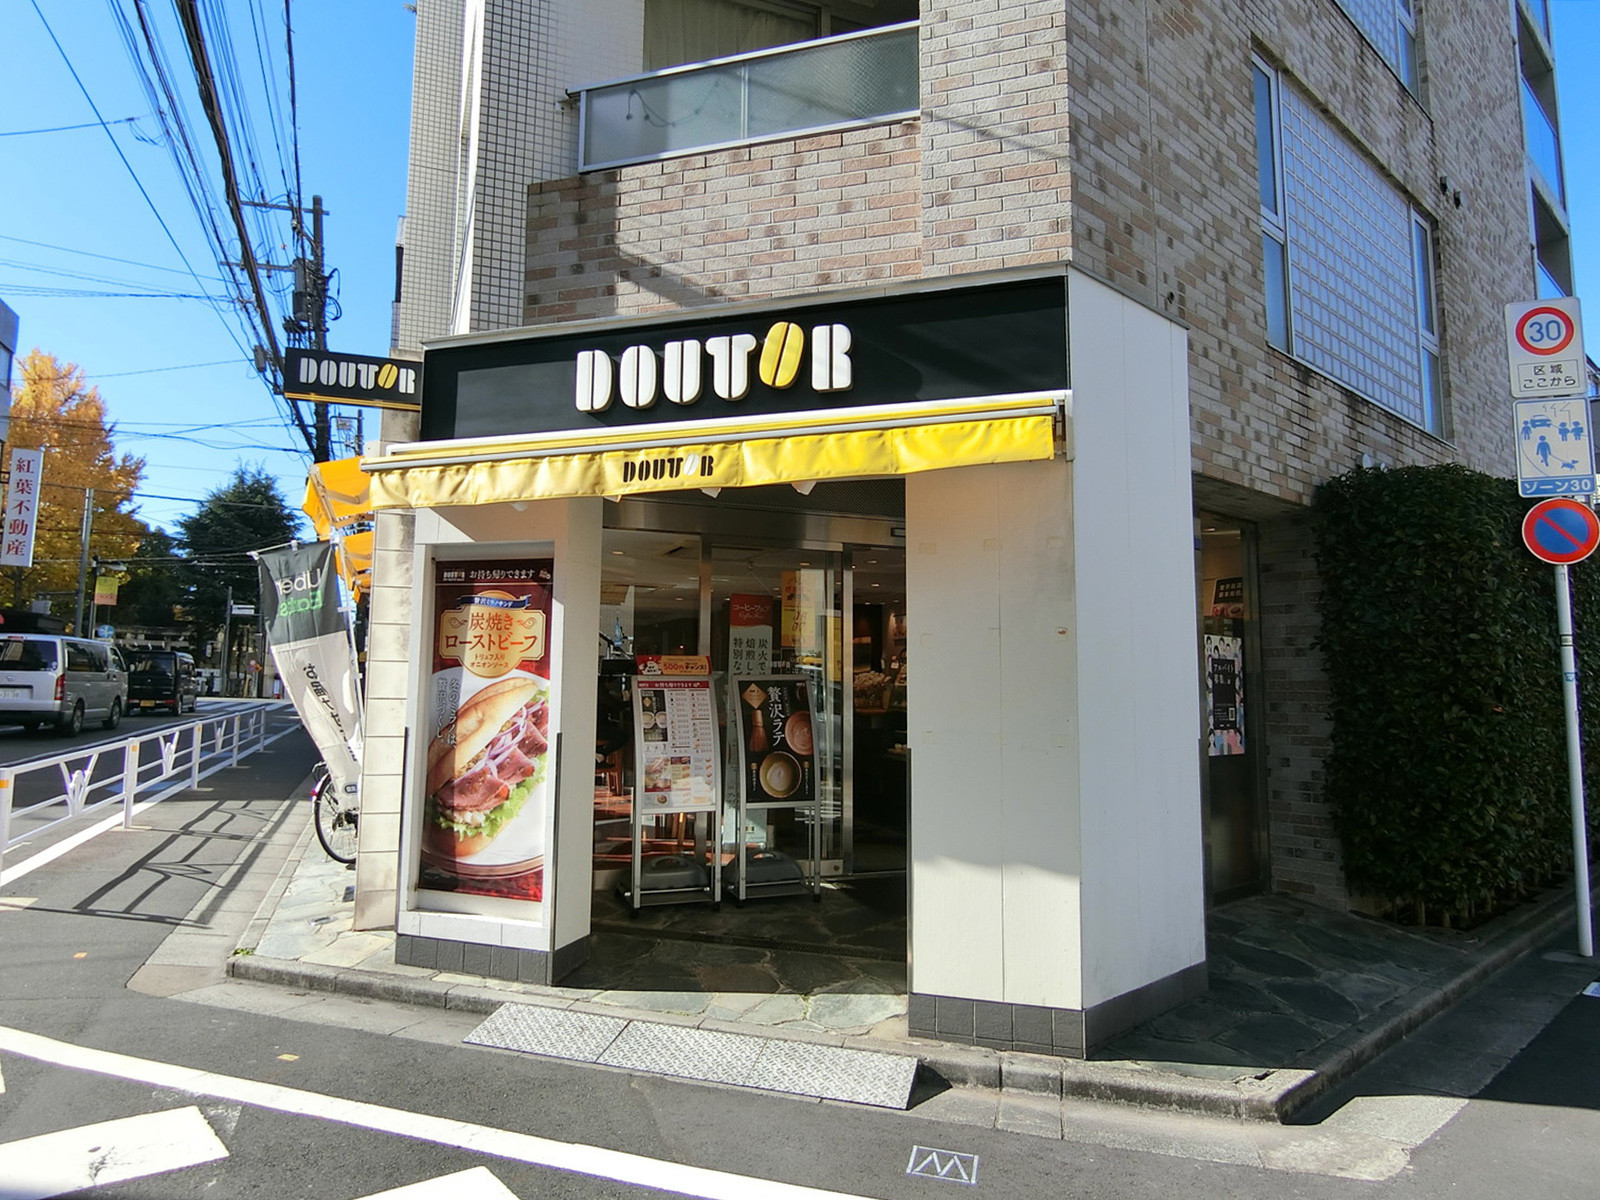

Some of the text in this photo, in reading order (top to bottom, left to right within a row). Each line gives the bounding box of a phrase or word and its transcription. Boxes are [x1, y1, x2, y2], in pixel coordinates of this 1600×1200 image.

[1529, 319, 1561, 343] 30
[299, 357, 416, 394] DOUTOR
[575, 321, 852, 413] DOUTOR
[1533, 364, 1563, 376] 区域
[1522, 375, 1576, 389] ここから
[623, 453, 714, 483] DOUTOR
[1524, 479, 1591, 494] ゾーン30
[6, 457, 35, 556] 紅葉不動産
[469, 569, 535, 579] お持ち帰りできます
[469, 612, 513, 631] 炭焼き
[445, 631, 538, 653] ローストビーフ
[470, 661, 509, 669] オニオンソース
[474, 653, 505, 661] トリュフ入り
[733, 638, 743, 675] 特別な
[746, 638, 756, 675] 焙煎し
[758, 638, 768, 675] 炭火で
[767, 686, 785, 746] 贅沢ラテ
